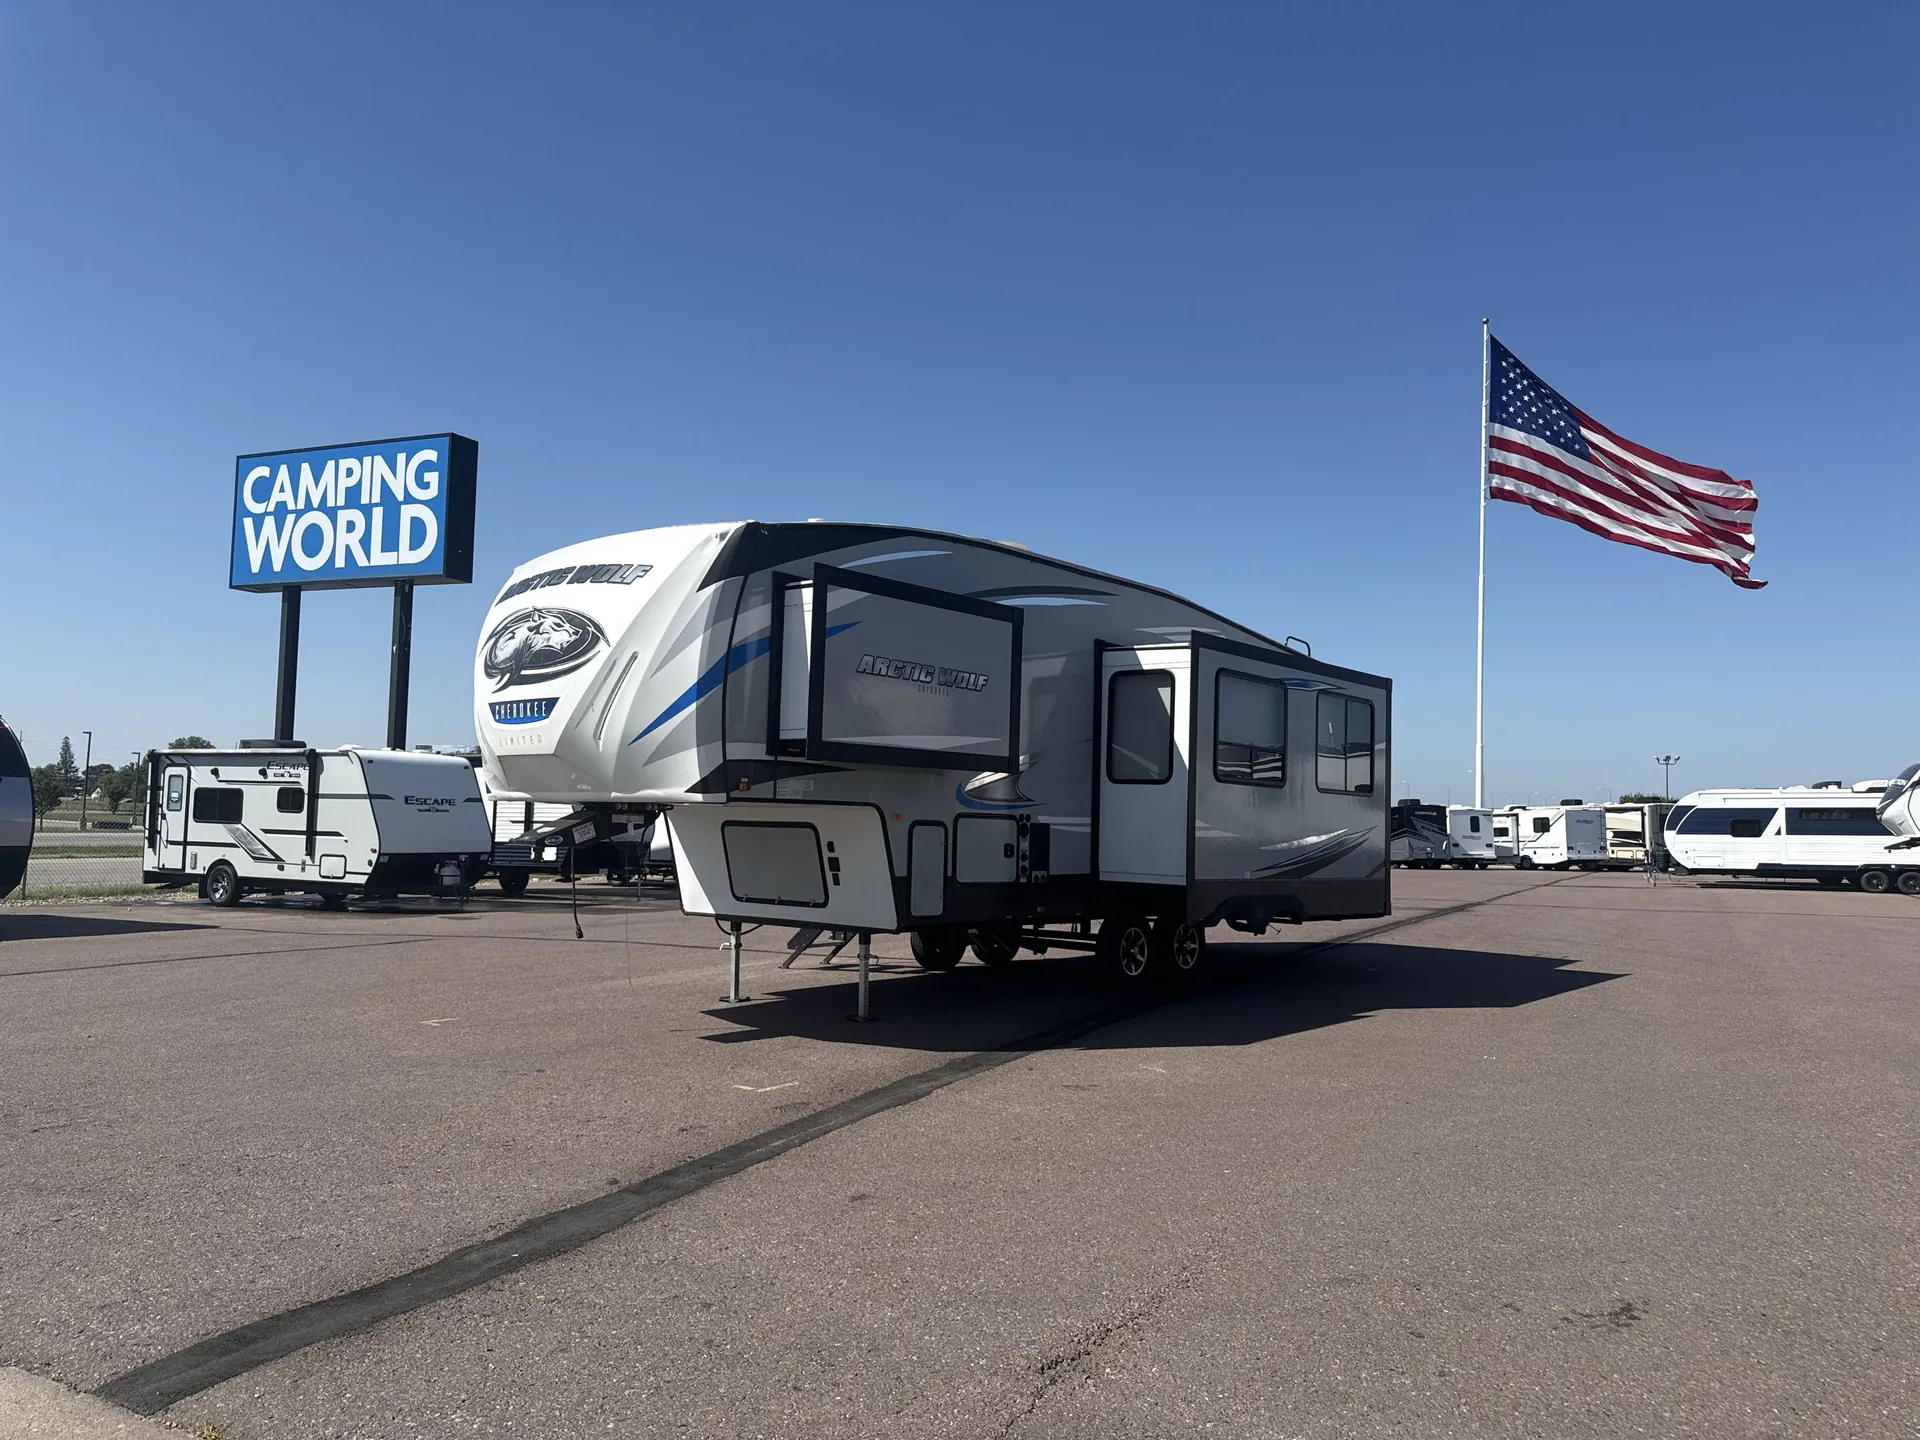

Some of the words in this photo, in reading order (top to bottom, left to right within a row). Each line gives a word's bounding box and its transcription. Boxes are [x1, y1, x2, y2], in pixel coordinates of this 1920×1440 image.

[243, 449, 439, 514] CAMPING
[242, 503, 438, 573] WORLD
[497, 566, 577, 605] ARCTIC
[567, 564, 654, 585] WOLF
[856, 653, 936, 684] ARCTIC
[938, 666, 988, 692] WOLF
[495, 701, 547, 720] CHEROKEE
[500, 734, 542, 747] LIMITED
[404, 795, 457, 806] ESCAPE
